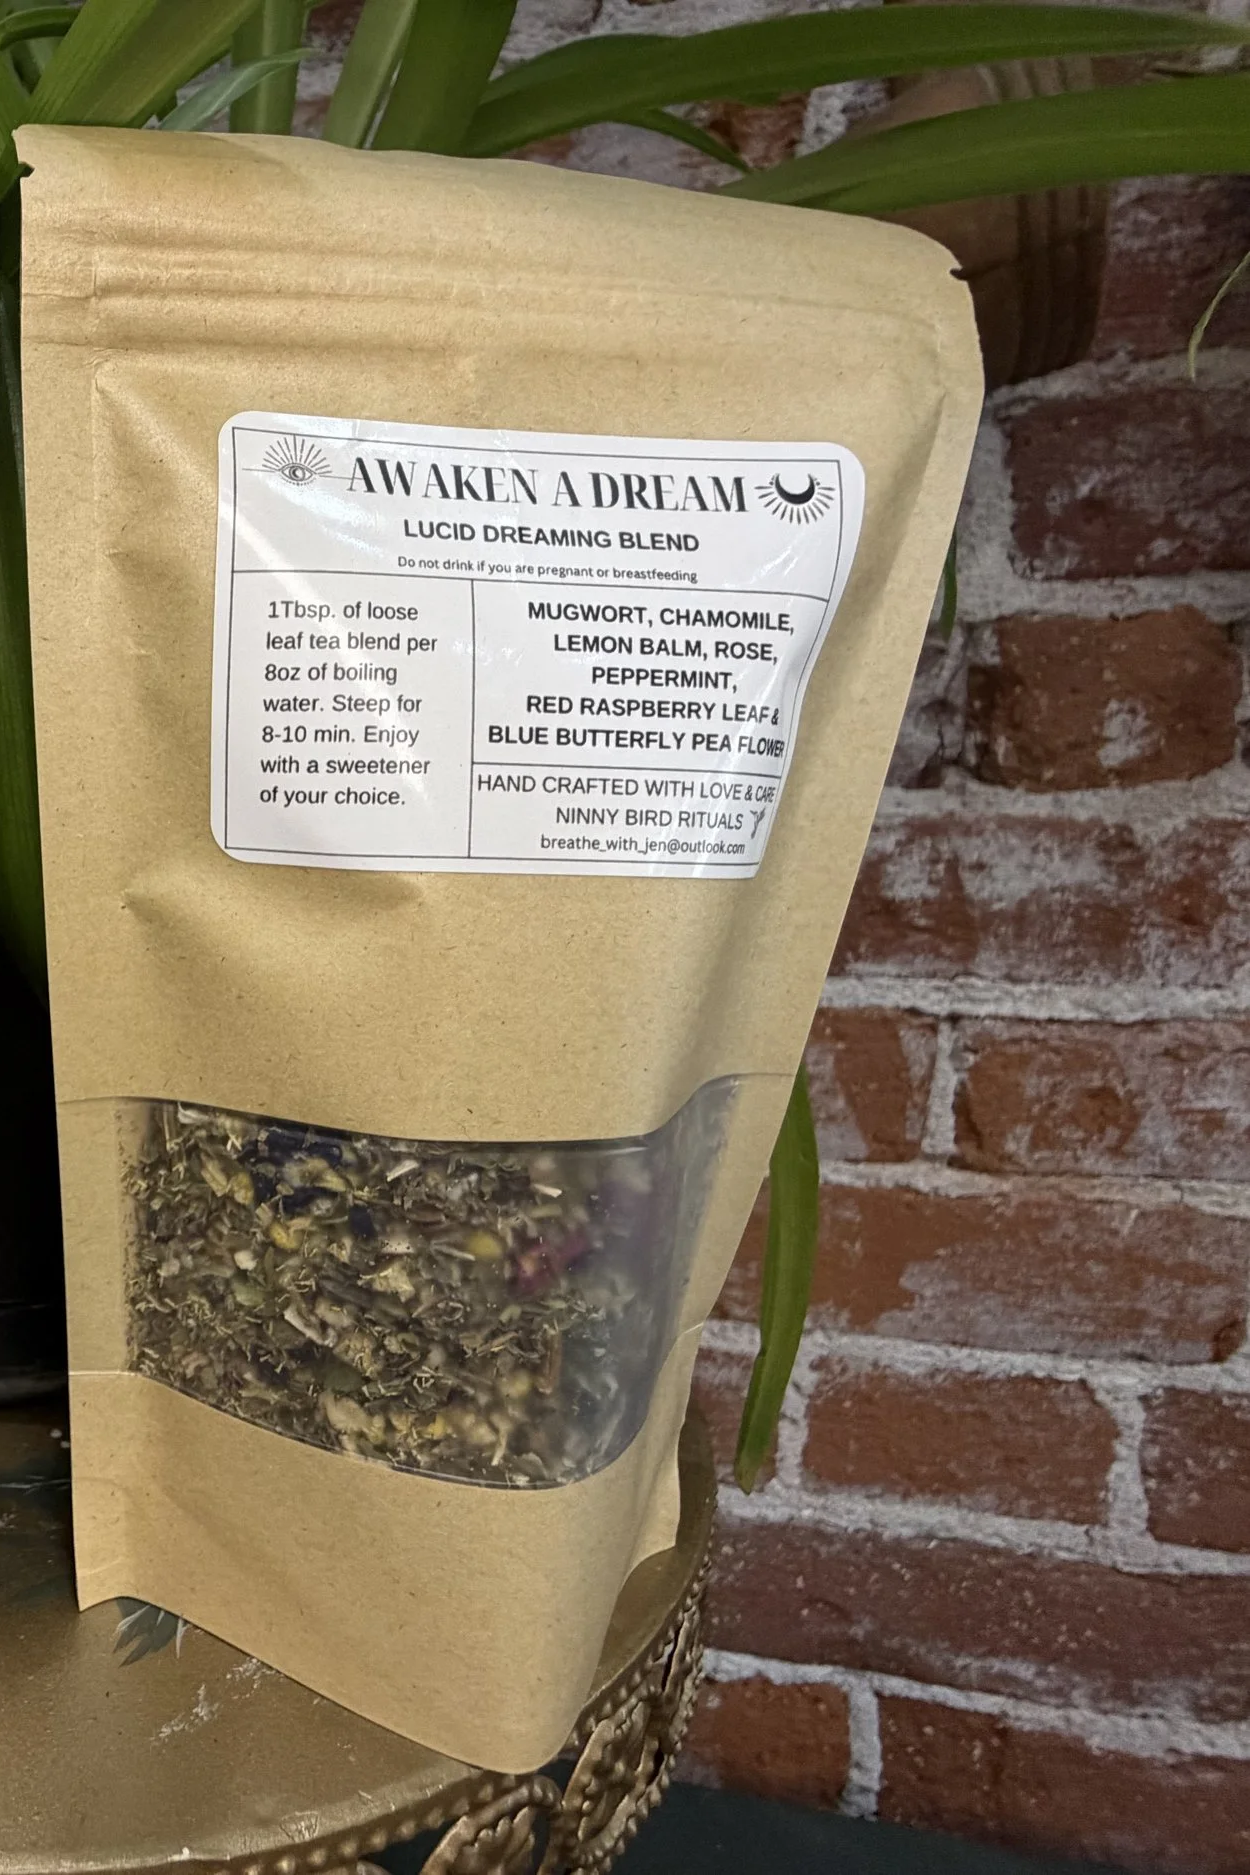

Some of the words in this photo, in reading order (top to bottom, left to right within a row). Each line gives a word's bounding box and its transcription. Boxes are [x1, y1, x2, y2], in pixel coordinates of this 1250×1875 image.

[347, 457, 538, 504] AWAKEN
[552, 472, 582, 507] A
[590, 472, 749, 512] DREAM
[404, 520, 476, 540] LUCID
[484, 525, 612, 548] DREAMING
[619, 532, 699, 552] BLEND
[398, 556, 416, 568] Do
[418, 559, 439, 569] not
[443, 560, 474, 571] drink
[477, 561, 485, 572] if
[488, 564, 512, 574] you
[515, 565, 534, 575] are
[538, 566, 594, 578] pregnant
[597, 569, 609, 578] or
[613, 567, 698, 583] breastfeeding
[343, 602, 362, 618] of
[368, 602, 418, 620] loose
[528, 602, 653, 628] MUGWORT,
[660, 609, 794, 635] CHAMOMILE,
[266, 633, 303, 649] leaf
[310, 635, 340, 650] tea
[348, 633, 401, 651] blend
[407, 636, 437, 655] per
[554, 634, 633, 654] LEMON
[640, 638, 708, 660] BALM,
[715, 641, 777, 665] ROSE,
[265, 664, 300, 681] 8oz
[308, 663, 328, 681] of
[334, 663, 397, 685] boiling
[592, 667, 737, 693] PEPPERMINT,
[263, 696, 324, 712] water.
[332, 695, 390, 715] Steep
[397, 695, 422, 712] for
[527, 696, 573, 714] RED
[581, 698, 715, 720] RASPBERRY
[723, 704, 769, 723] LEAF
[772, 708, 779, 724] &
[262, 726, 306, 743] 8-10
[315, 726, 355, 743] min.
[364, 726, 419, 747] Enjoy
[489, 726, 549, 745] BLUE
[557, 728, 686, 750] BUTTERFLY
[692, 734, 731, 752] PEA
[738, 736, 785, 758] FLOWER
[261, 756, 299, 773] with
[307, 760, 319, 773] a
[326, 758, 430, 774] sweetener
[260, 787, 278, 802] of
[284, 789, 328, 807] your
[335, 787, 405, 805] choice.
[478, 775, 536, 793] HAND
[543, 776, 638, 796] CRAFTED
[645, 780, 694, 798] WITH
[700, 783, 741, 799] LOVE
[745, 786, 752, 801] &
[755, 787, 775, 803] CARE
[556, 807, 619, 825] NINNY
[626, 810, 672, 827] BIRD
[678, 812, 743, 830] RITUALS
[541, 834, 745, 854] breathe_with_jen@outlook.com
